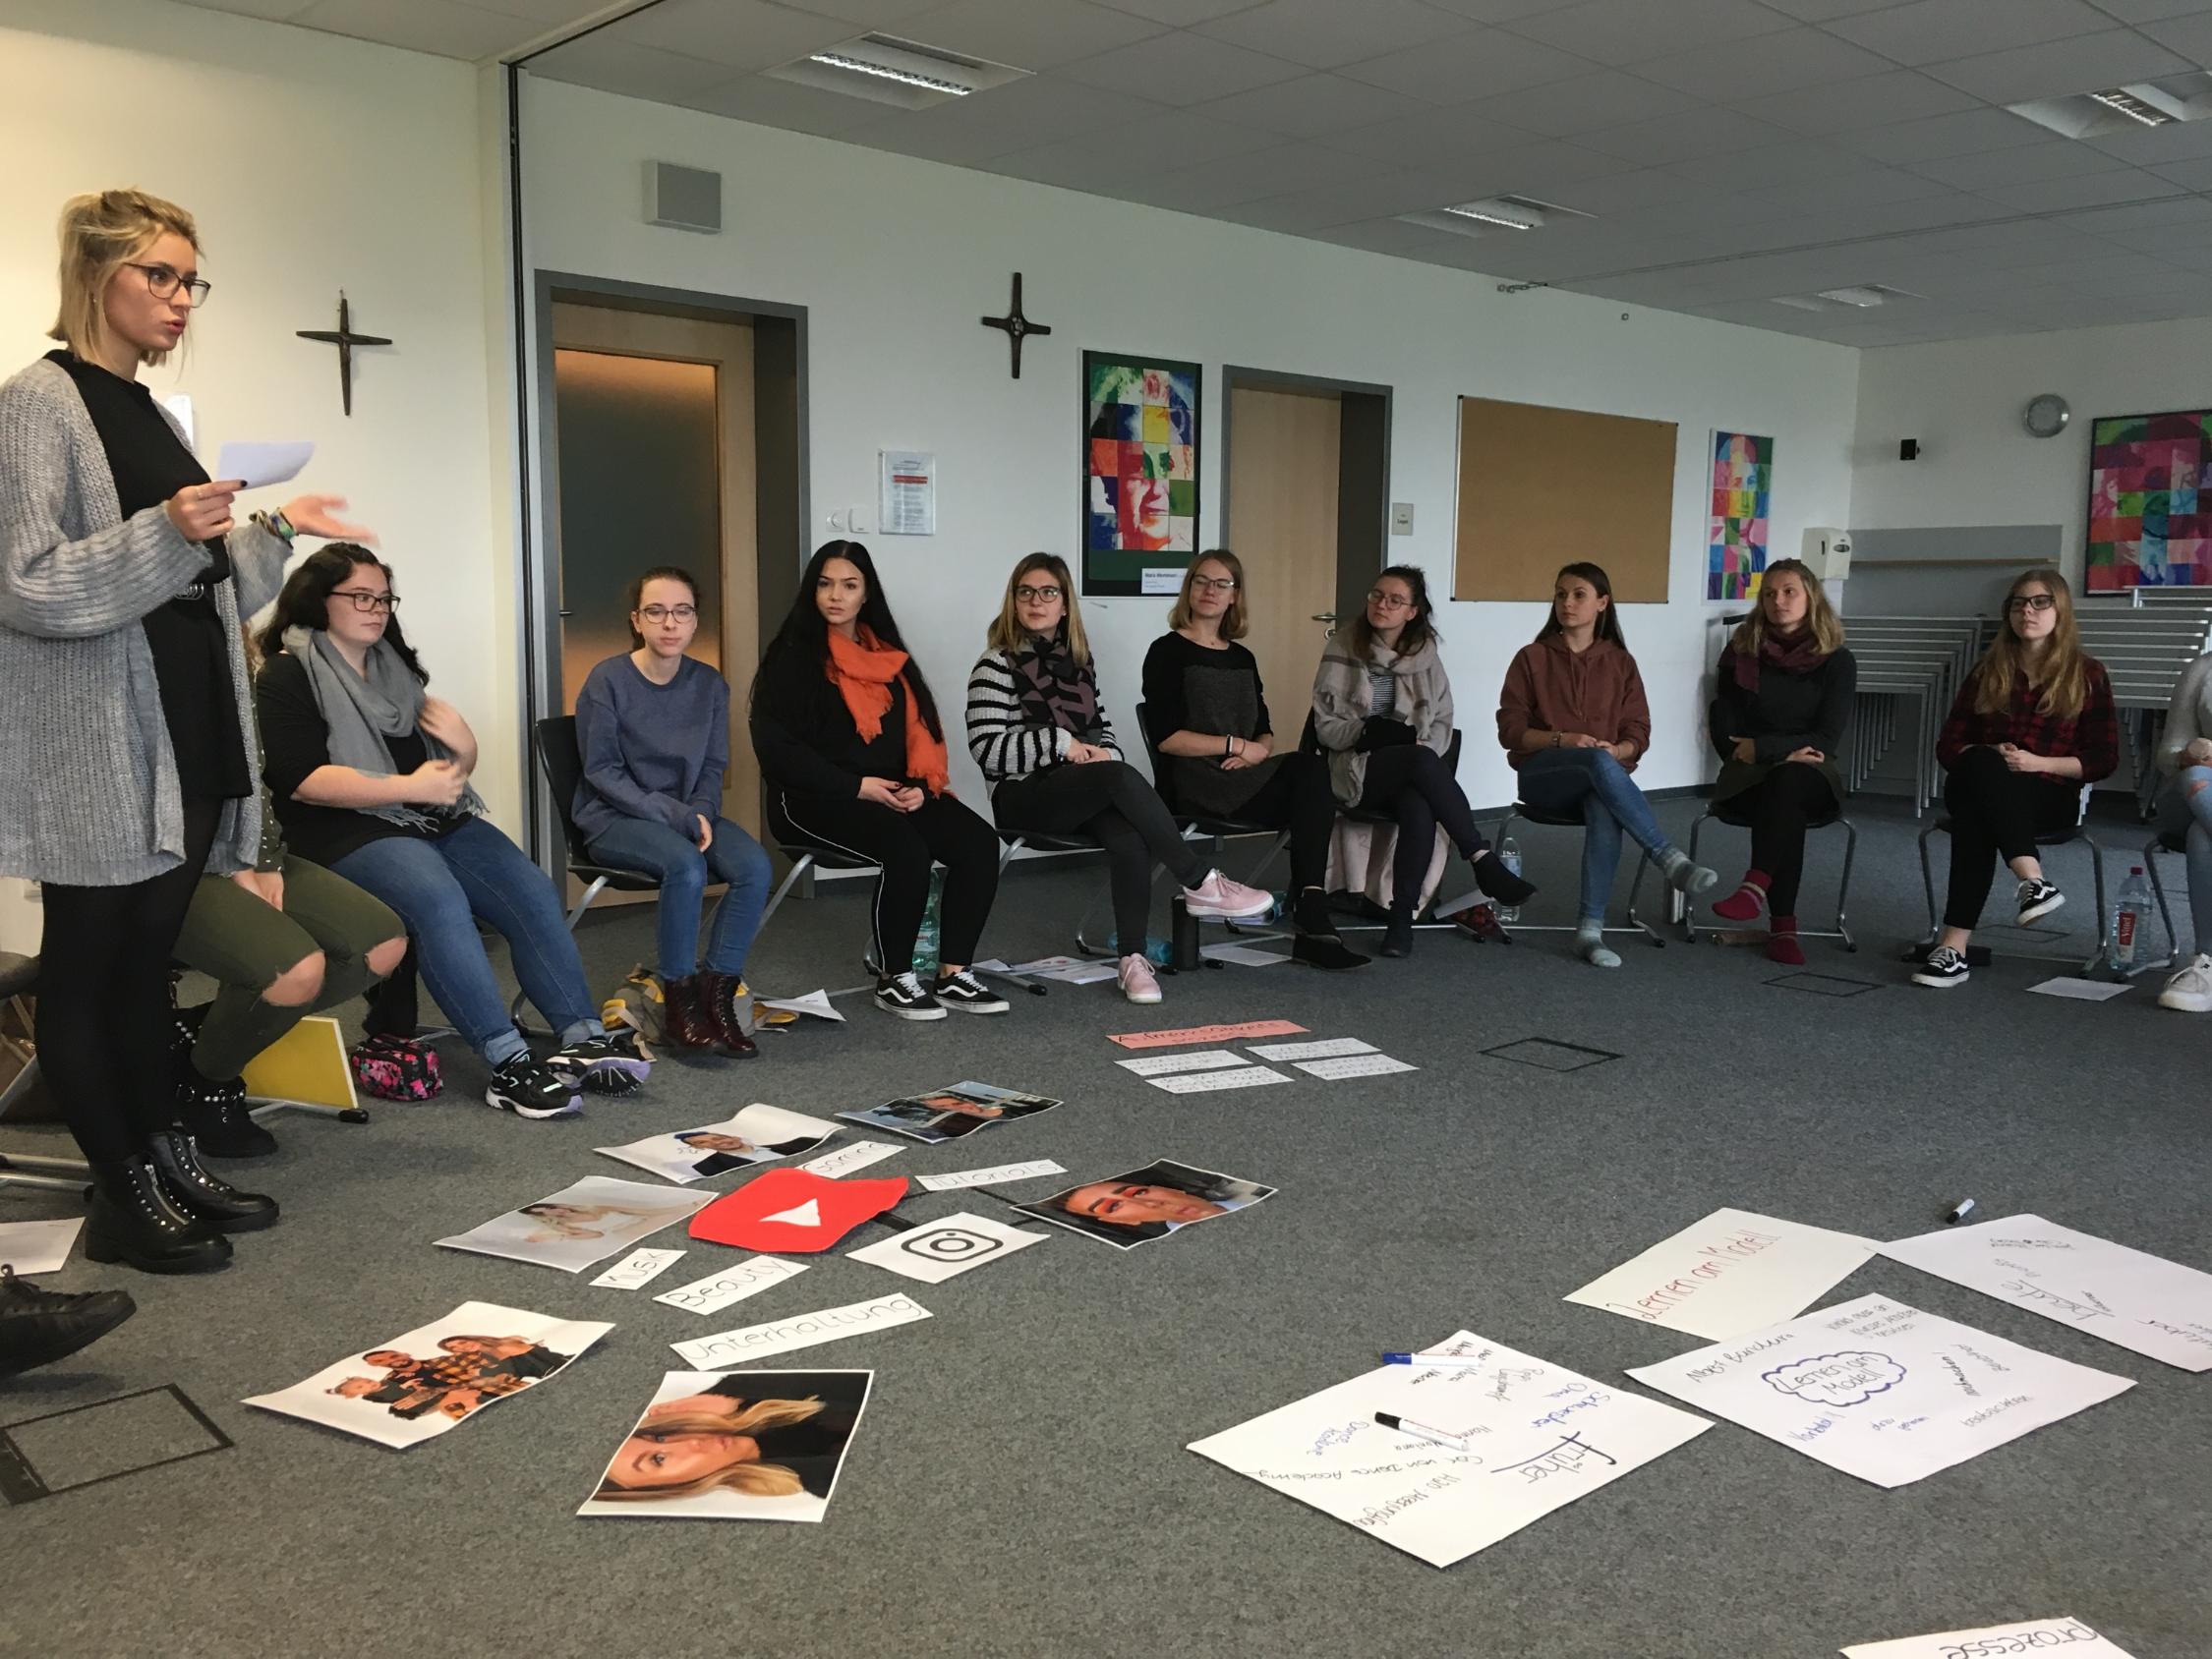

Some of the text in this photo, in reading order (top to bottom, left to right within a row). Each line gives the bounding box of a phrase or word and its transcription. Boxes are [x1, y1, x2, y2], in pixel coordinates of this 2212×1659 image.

[919, 1163, 1059, 1187] Tutorials
[596, 1251, 671, 1287] Musik
[665, 1260, 792, 1307] Beauty
[1605, 1229, 1782, 1321] Lernen am Modell
[676, 1298, 922, 1361] Unterhaltung
[1775, 1354, 1880, 1392] Lernen am
[1821, 1366, 1887, 1396] Modell
[1519, 1435, 1617, 1484] früher
